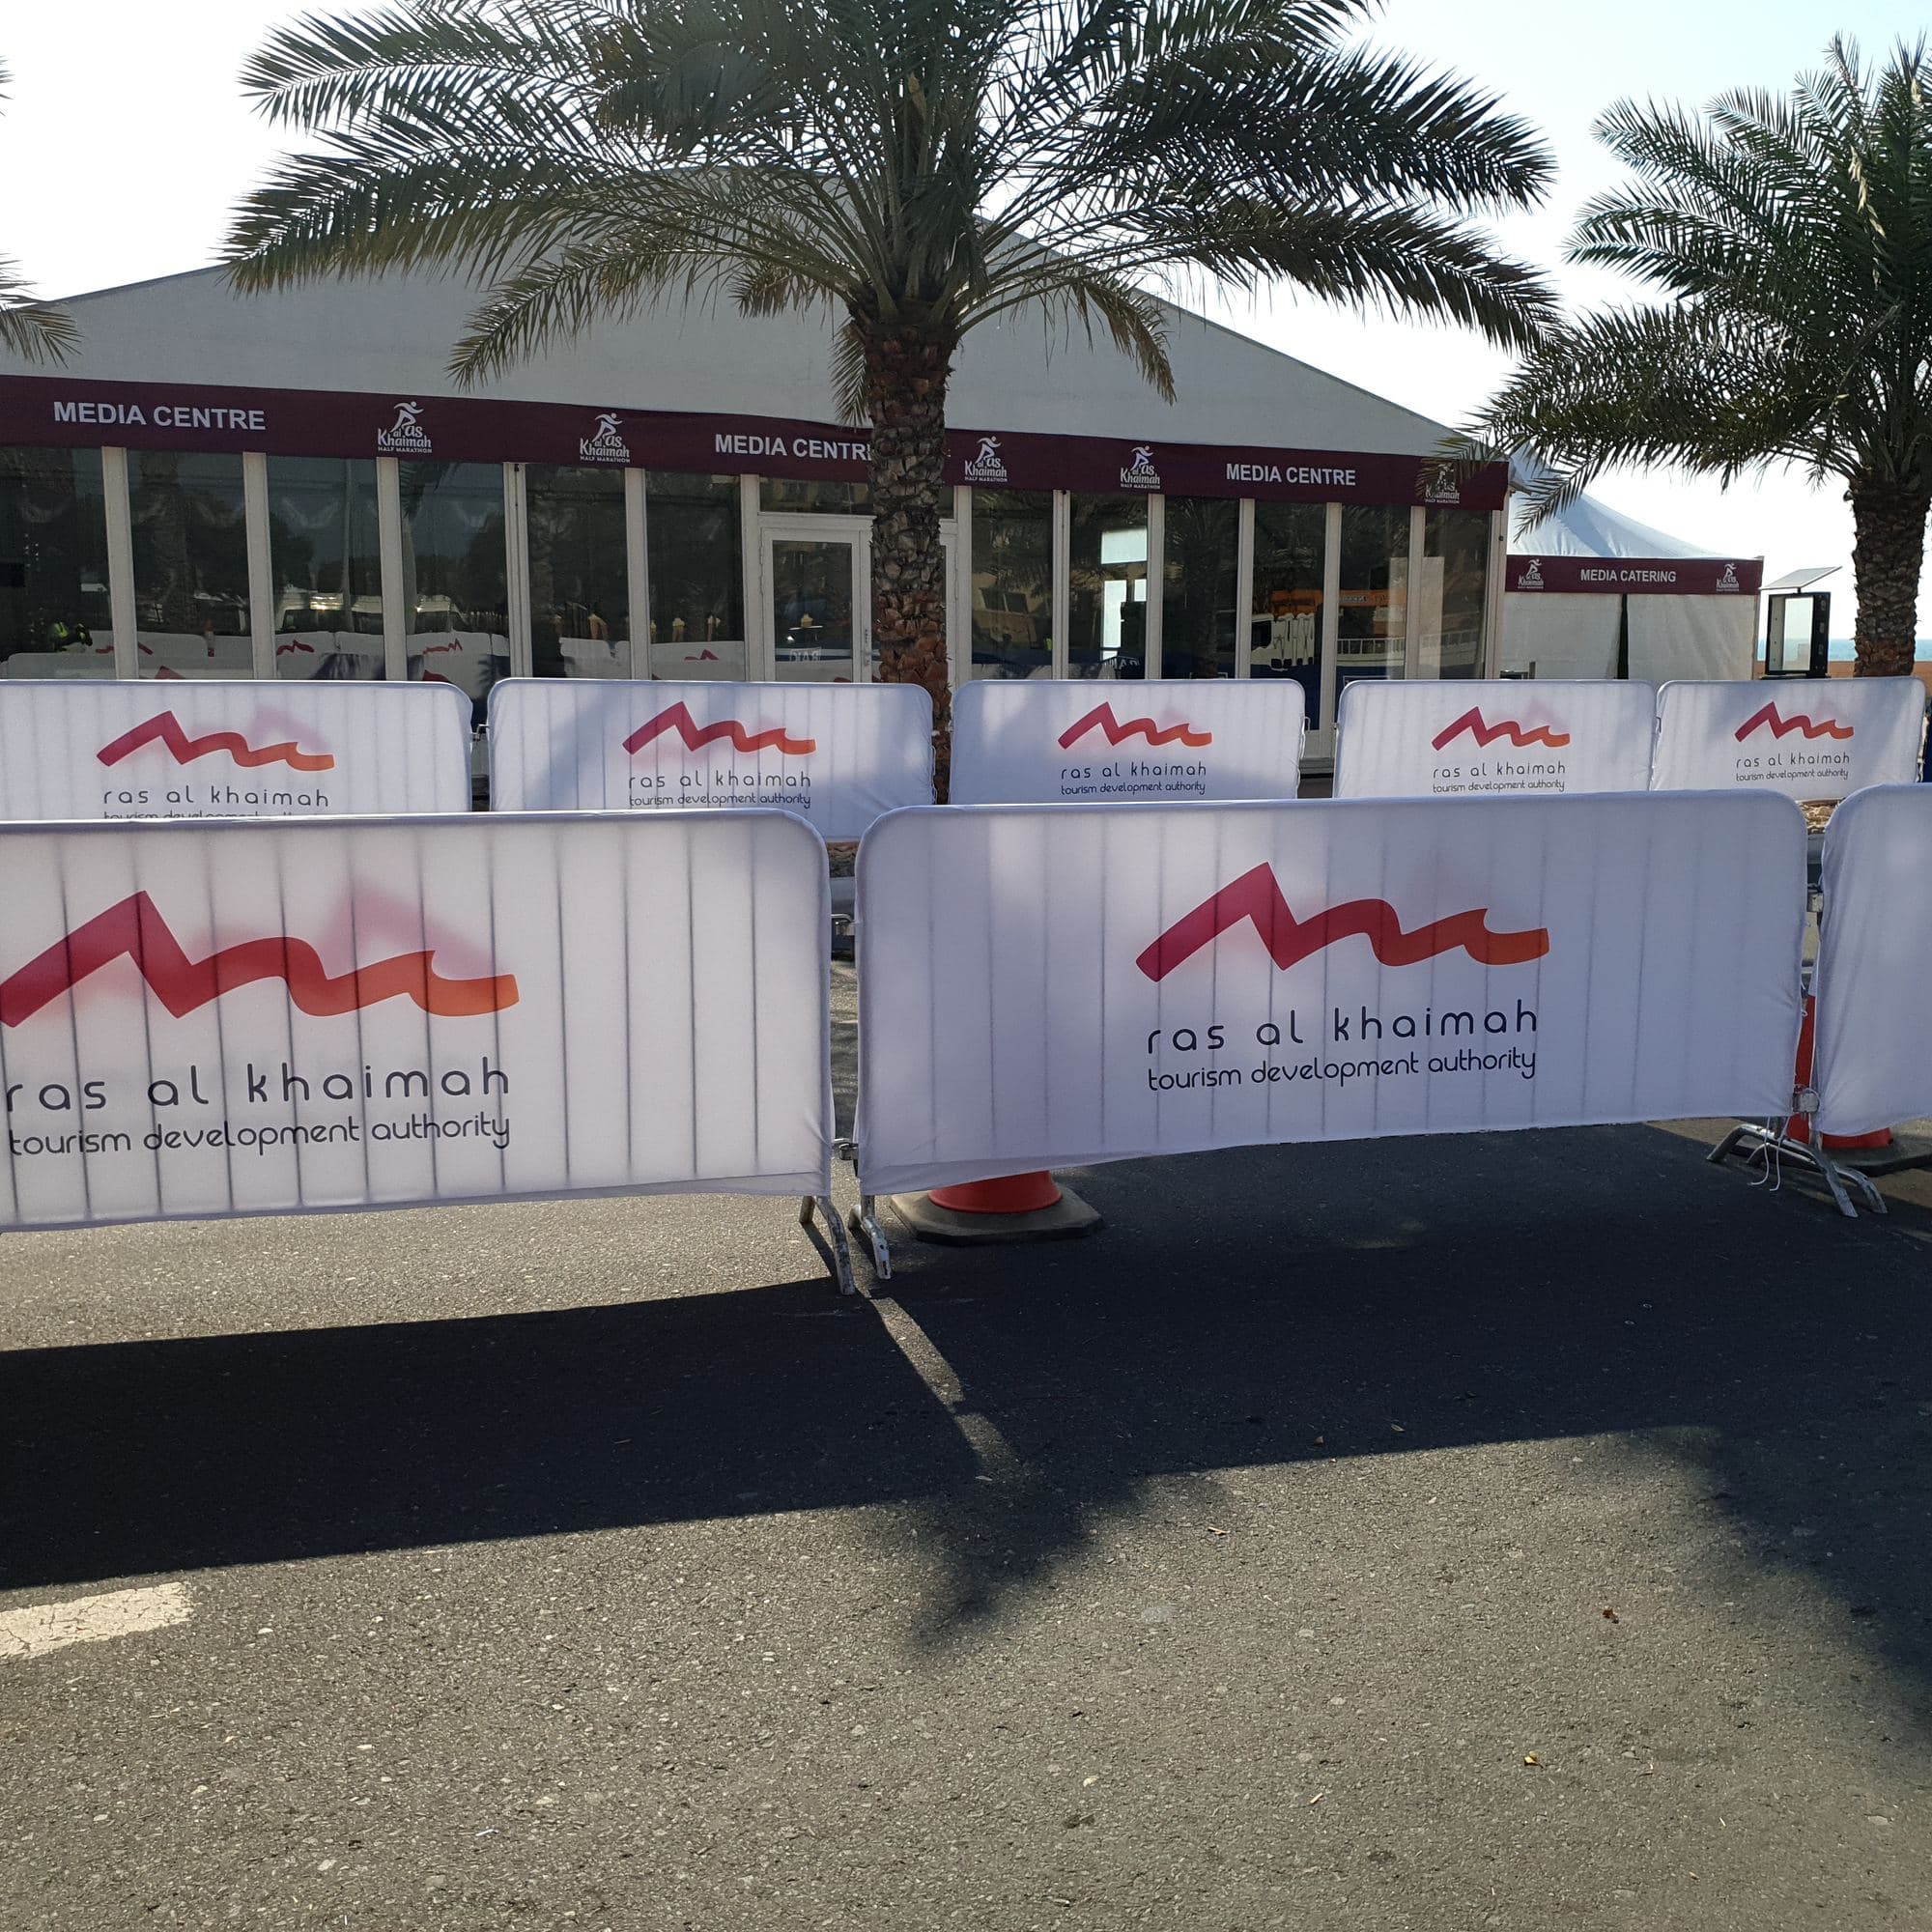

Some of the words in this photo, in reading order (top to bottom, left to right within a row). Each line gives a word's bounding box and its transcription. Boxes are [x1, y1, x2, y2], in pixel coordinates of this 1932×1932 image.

[53, 401, 146, 425] MEDIA
[153, 406, 266, 430] CENTRE
[378, 428, 432, 447] Khaimah
[715, 434, 787, 456] MEDIA
[580, 438, 630, 458] Khaimah
[964, 460, 1008, 477] Khaimah
[1121, 467, 1160, 484] Khaimah
[1226, 463, 1282, 482] MEDIA
[1286, 467, 1356, 486] CENTRE
[1580, 569, 1618, 582] MEDIA
[1620, 570, 1676, 582] CATERING
[1433, 767, 1460, 778] ras
[1470, 762, 1487, 776] al
[1496, 761, 1566, 776] khaimah
[1736, 757, 1760, 768] ras
[1768, 753, 1782, 766] al
[1791, 752, 1850, 765] khaimah
[629, 776, 666, 788] ras
[679, 770, 702, 787] al
[716, 770, 810, 787] khaimah
[1061, 767, 1091, 780] ras
[1102, 762, 1120, 777] al
[1131, 761, 1207, 777] khaimah
[1736, 773, 1765, 781] tourism
[1766, 769, 1815, 781] development
[1817, 768, 1849, 781] authority
[104, 790, 149, 804] ras
[166, 785, 193, 803] al
[212, 785, 328, 807] khaimah
[1061, 785, 1097, 795] tourism
[1100, 781, 1162, 795] development
[1166, 781, 1206, 795] authority
[1433, 783, 1465, 793] tourism
[1468, 780, 1525, 792] development
[1528, 780, 1565, 792] authority
[629, 795, 673, 807] tourism
[678, 793, 755, 807] development
[760, 793, 810, 810] authority
[1148, 1025, 1225, 1054] ras
[1256, 1009, 1303, 1045] al
[1334, 999, 1537, 1041] khaimah
[1148, 1067, 1241, 1091] tourism
[1251, 1052, 1419, 1087] development
[1428, 1047, 1536, 1079] authority
[6, 1081, 107, 1113] ras
[148, 1065, 210, 1106] al
[247, 1057, 509, 1102] khaimah
[9, 1128, 131, 1156] tourism
[144, 1116, 360, 1155] development
[372, 1111, 510, 1150] authority
